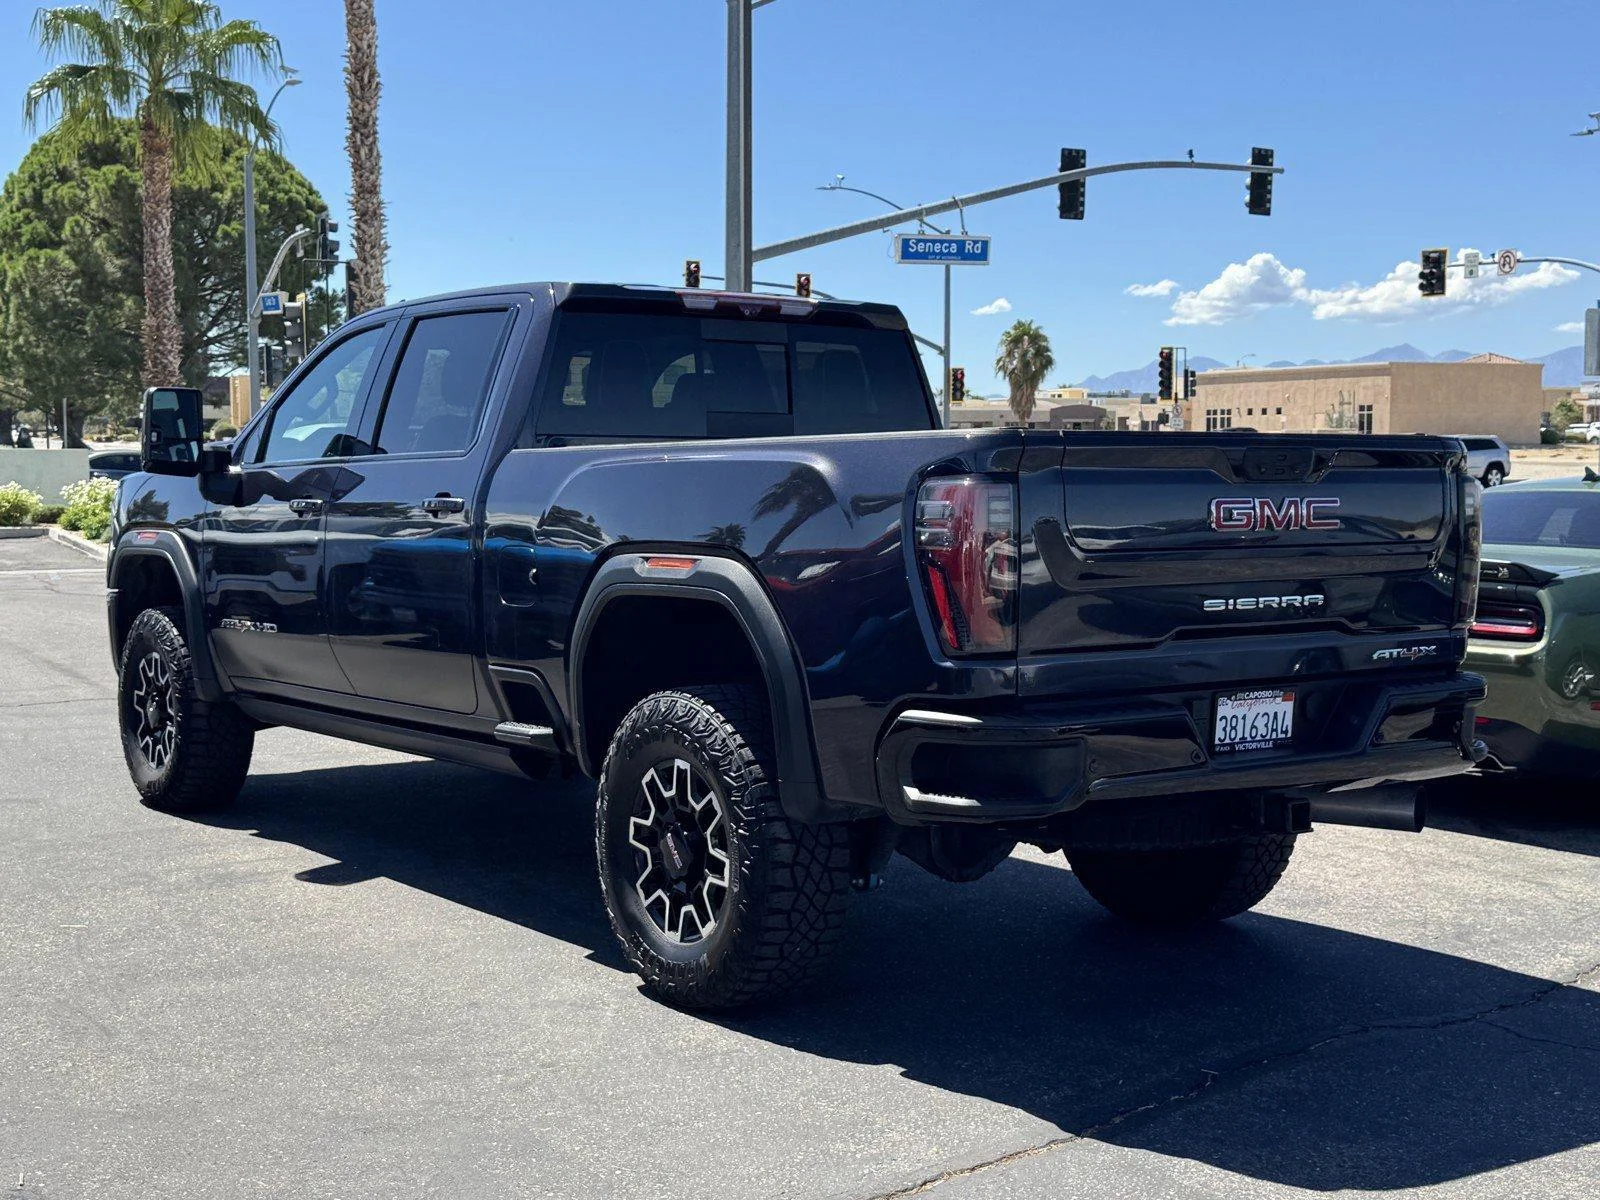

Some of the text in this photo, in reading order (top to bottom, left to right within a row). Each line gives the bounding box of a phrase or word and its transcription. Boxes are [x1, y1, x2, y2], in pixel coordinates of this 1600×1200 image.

[908, 239, 982, 254] Seneca Rd
[1211, 497, 1341, 532] GMC
[1203, 594, 1325, 611] SIERRA
[1372, 645, 1437, 661] AT4X
[1244, 690, 1273, 700] CAPOSIO
[1217, 710, 1289, 743] 38163A4
[1234, 740, 1274, 751] VICTORVILLE
